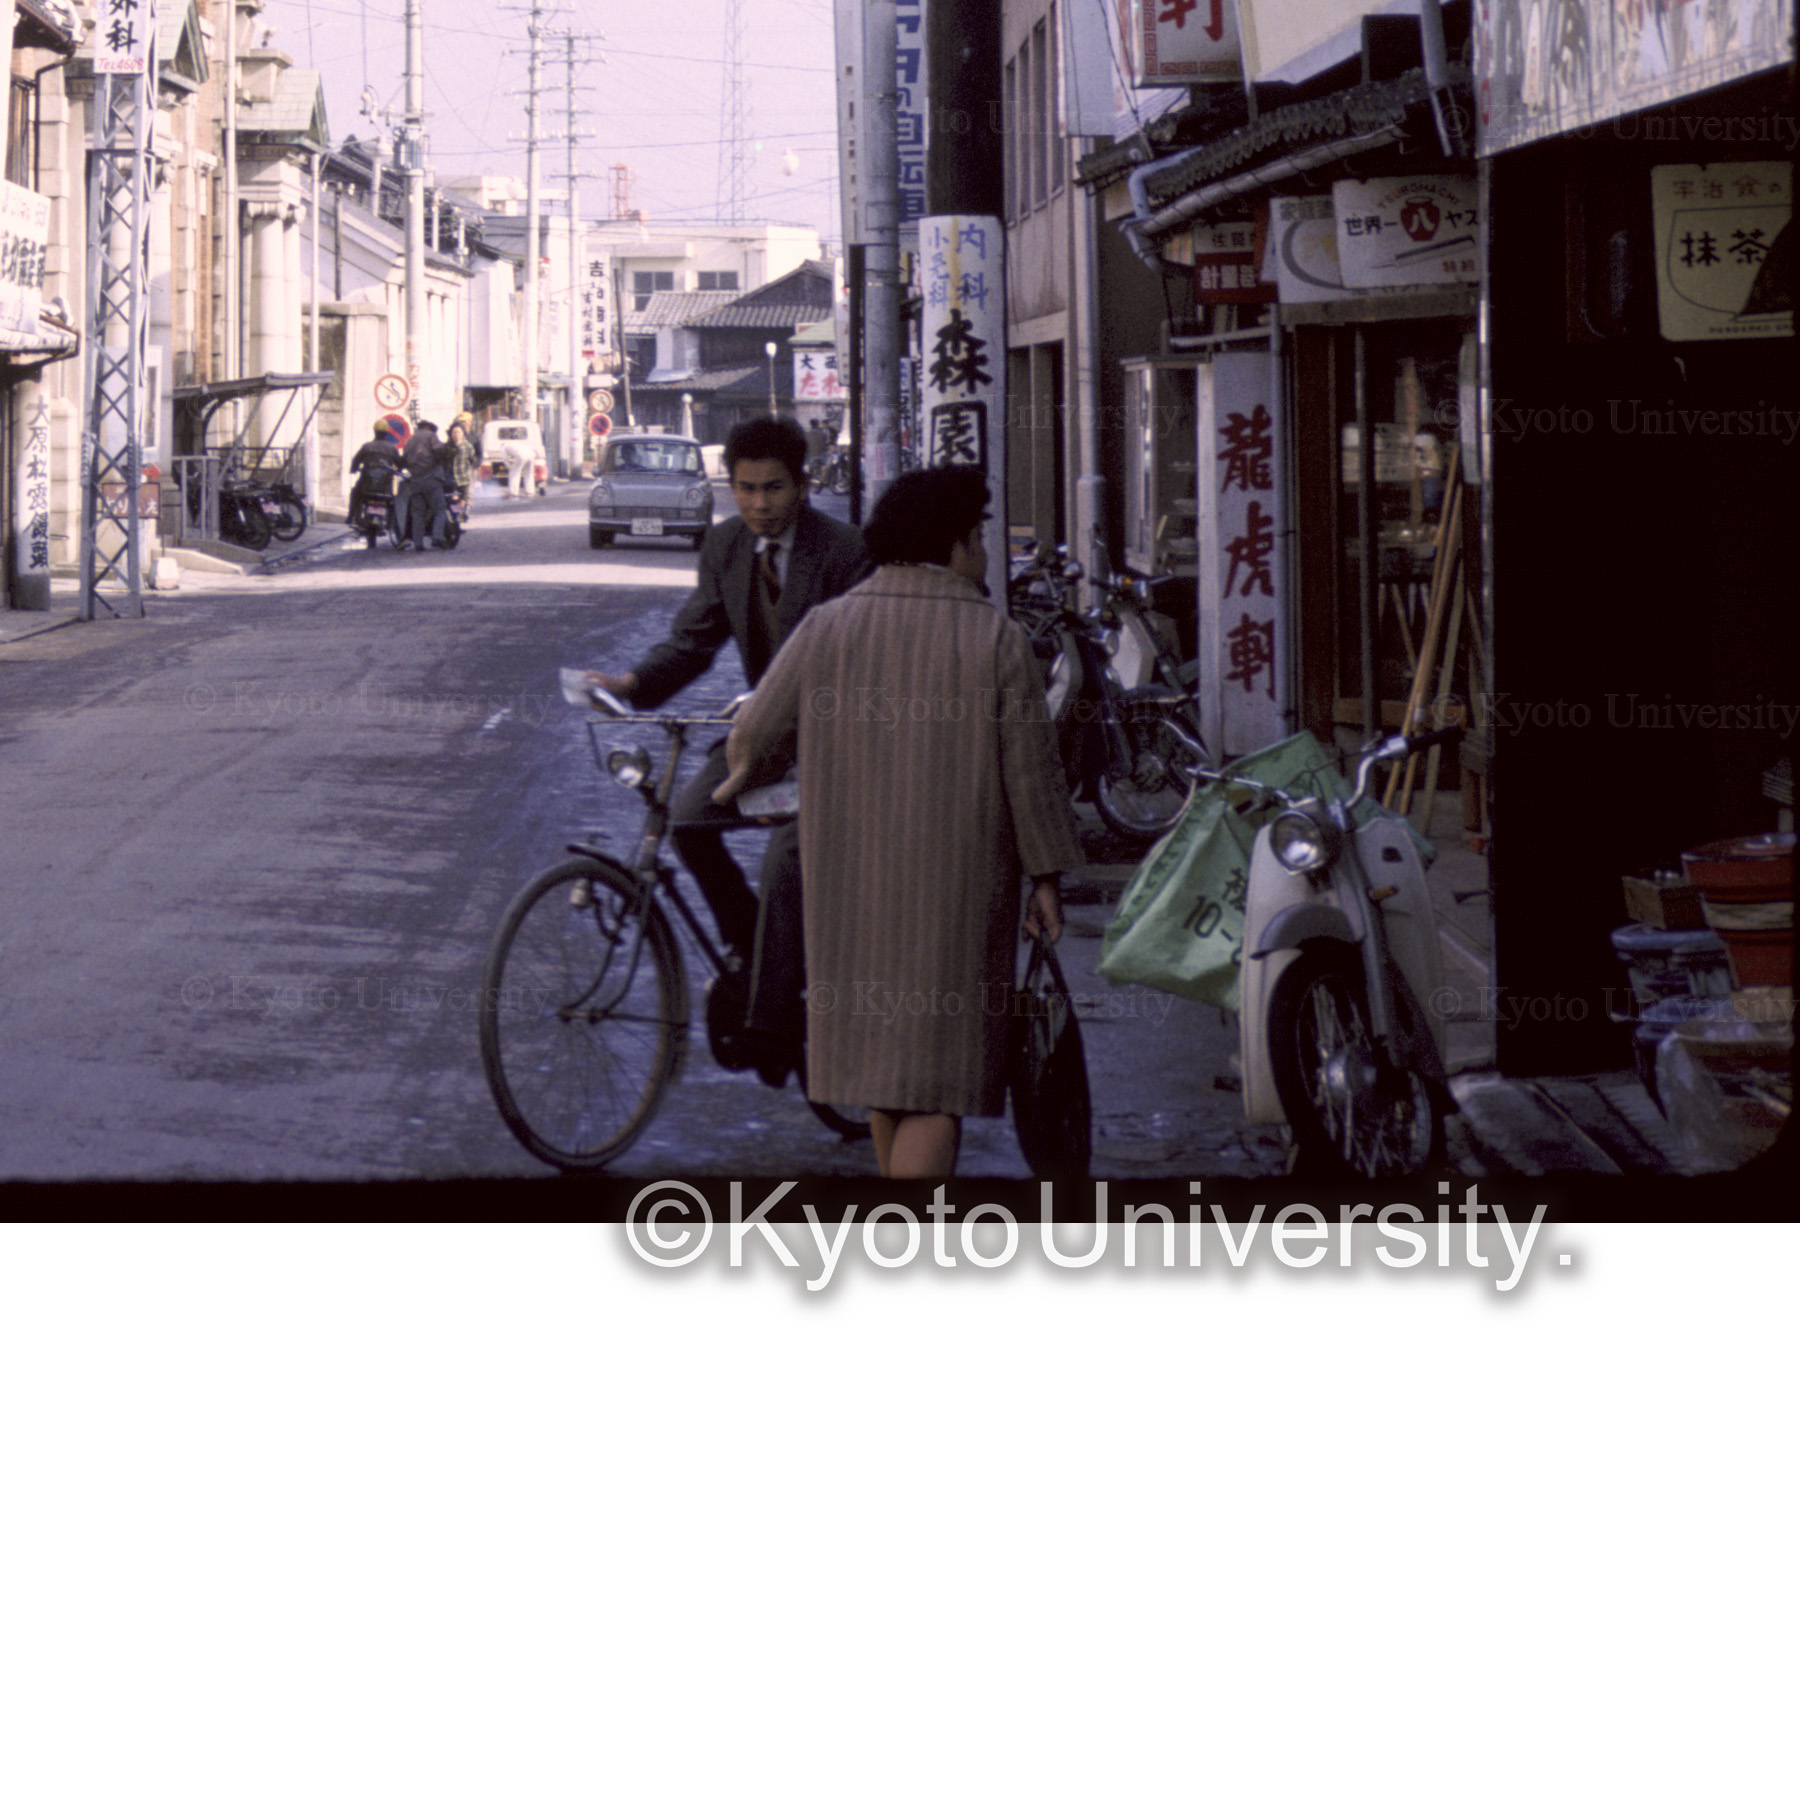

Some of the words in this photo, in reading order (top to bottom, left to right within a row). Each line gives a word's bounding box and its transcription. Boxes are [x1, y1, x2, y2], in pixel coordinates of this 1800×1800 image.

[927, 225, 950, 308] 小児科
[957, 222, 989, 310] 内科
[1344, 212, 1398, 237] 世界一
[1678, 227, 1772, 270] 抹茶
[929, 308, 993, 470] 森園
[1217, 405, 1277, 702] 龍虎軒
